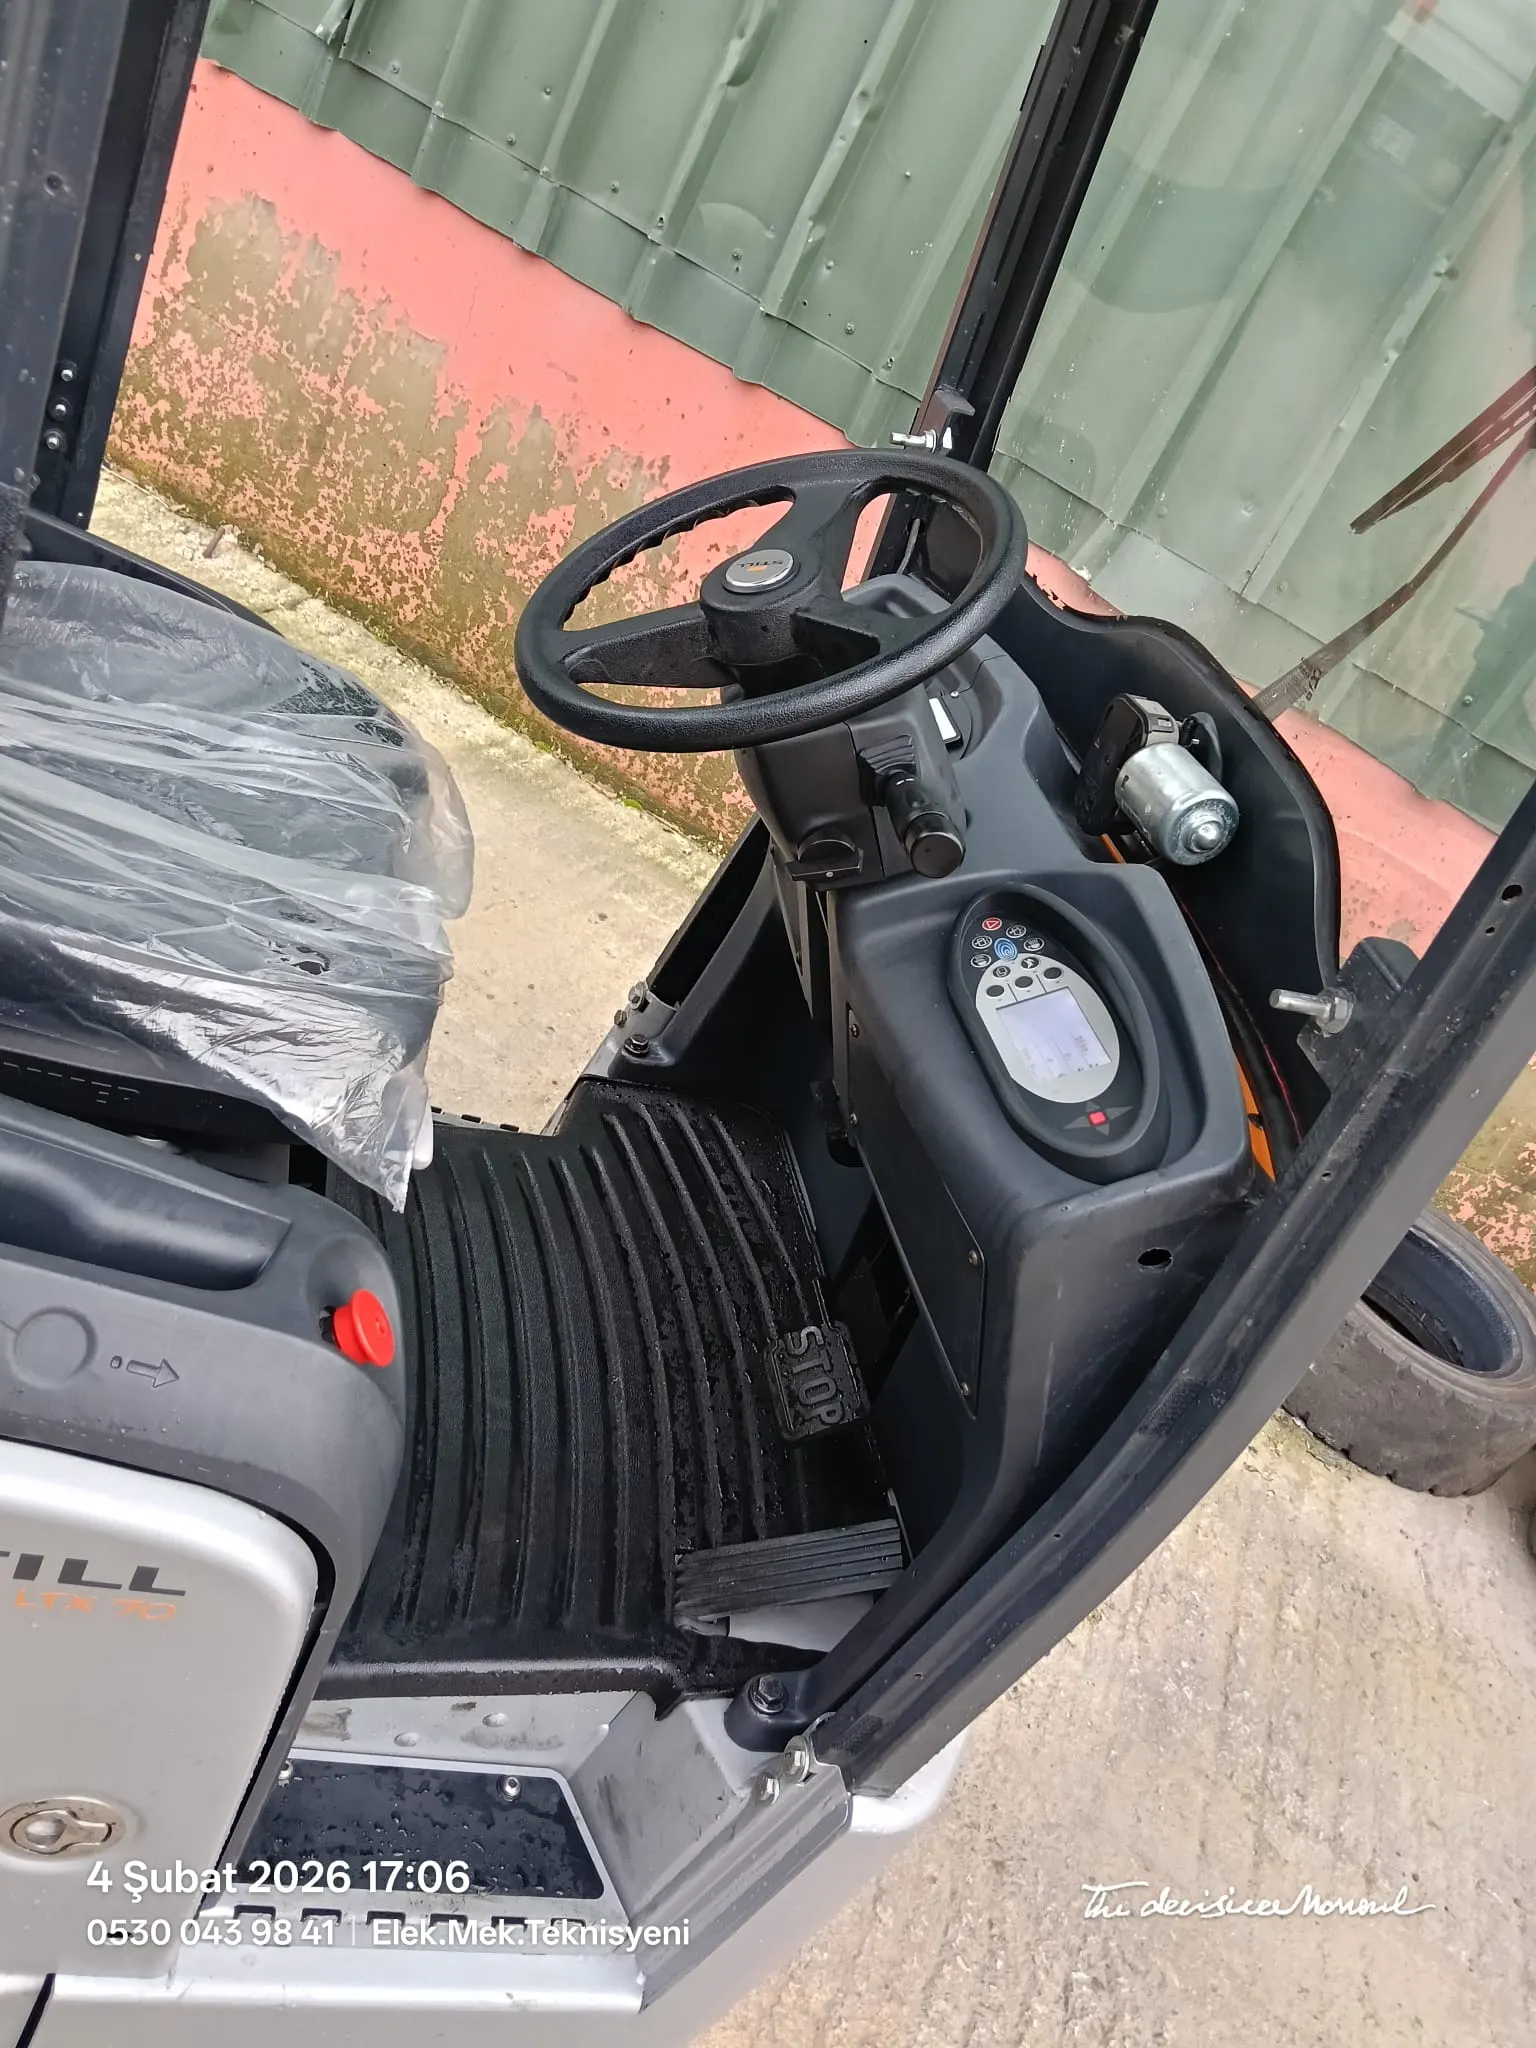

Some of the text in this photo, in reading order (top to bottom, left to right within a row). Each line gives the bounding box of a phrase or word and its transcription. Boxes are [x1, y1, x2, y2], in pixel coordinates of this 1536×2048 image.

[785, 1325, 843, 1424] STOP
[16, 1588, 177, 1620] LTX 70
